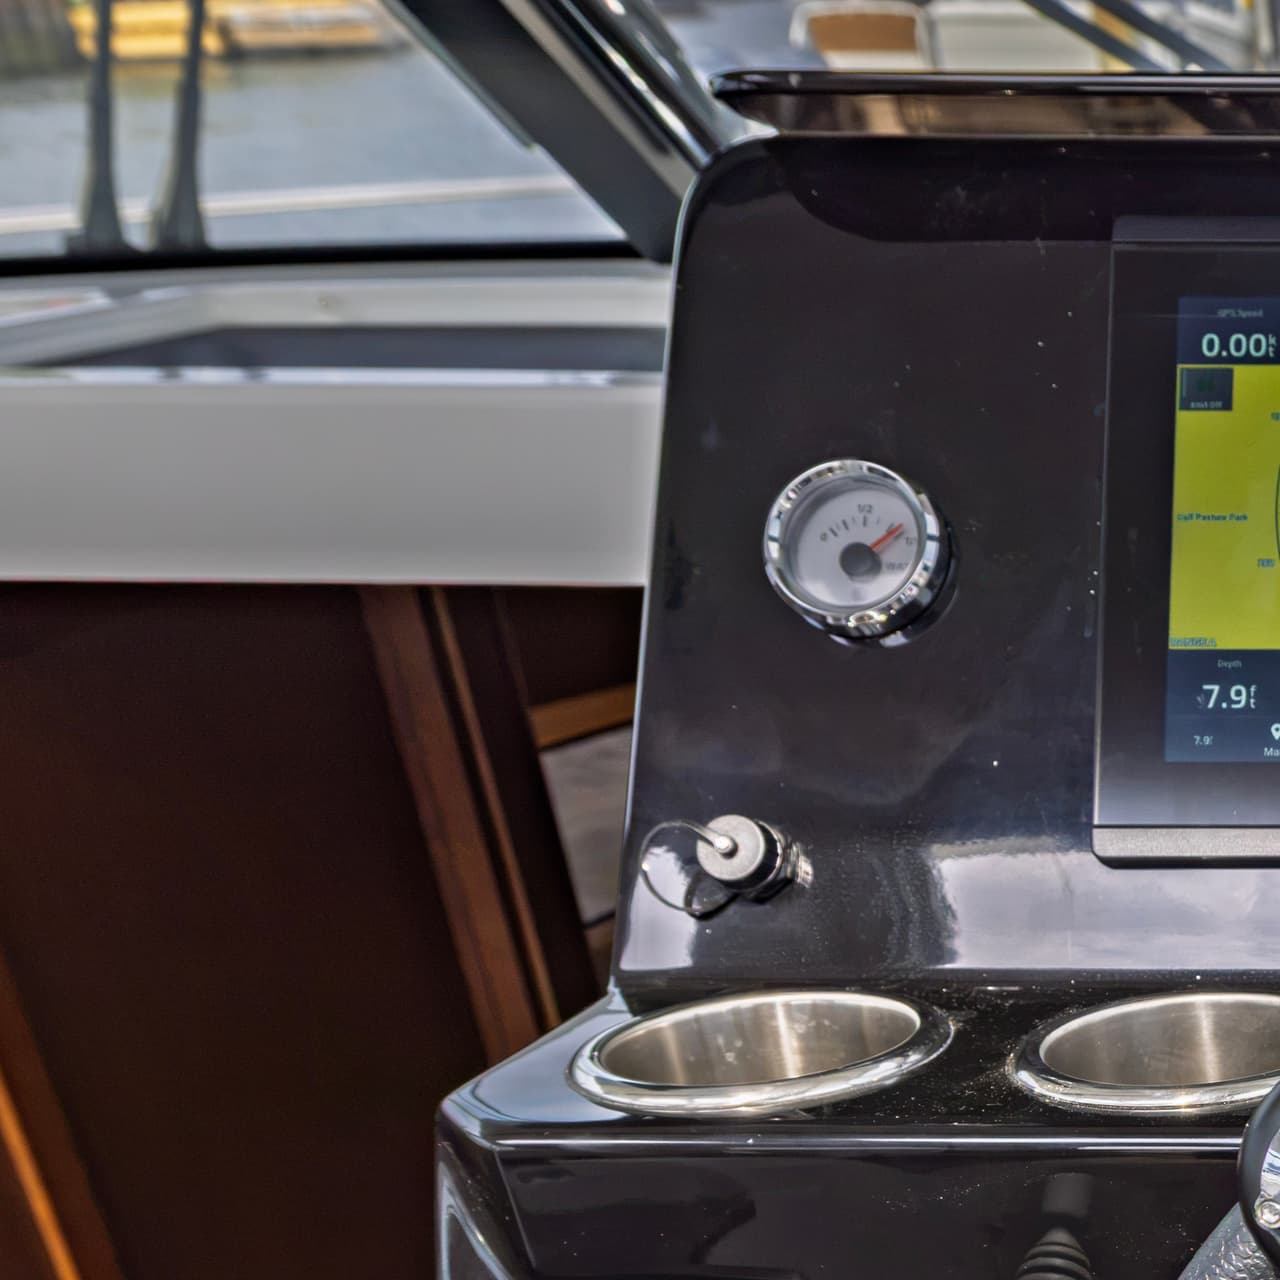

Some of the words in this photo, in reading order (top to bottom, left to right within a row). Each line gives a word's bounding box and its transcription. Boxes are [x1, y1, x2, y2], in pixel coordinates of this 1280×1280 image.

[1201, 333, 1267, 357] 0.00
[1217, 659, 1242, 669] Depth
[1202, 684, 1247, 709] 7.9
